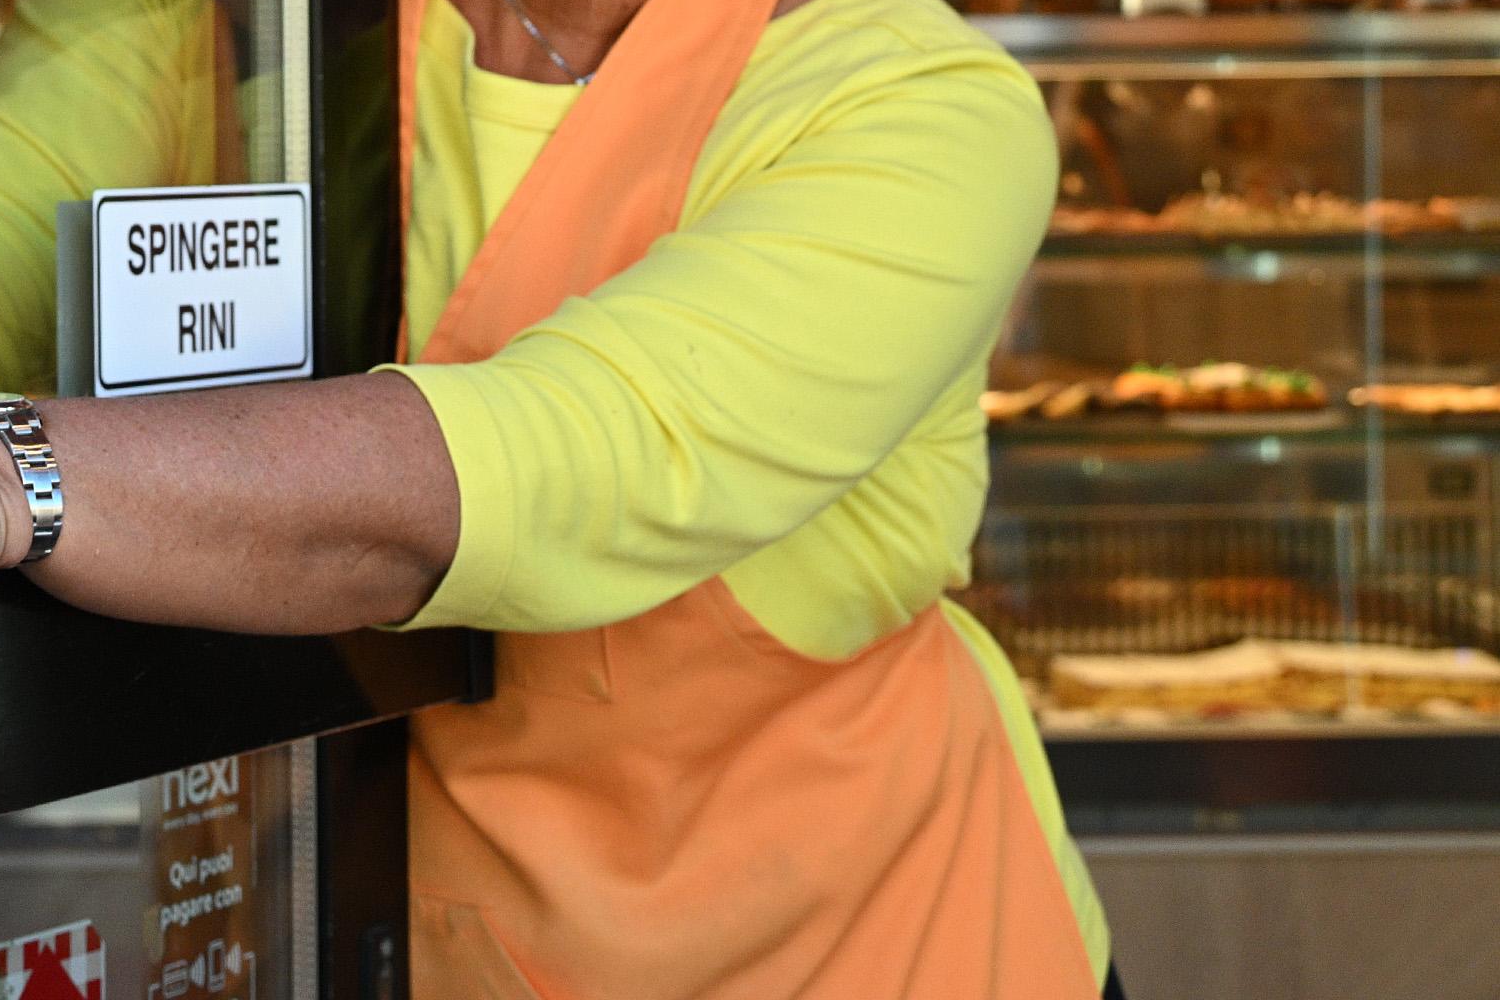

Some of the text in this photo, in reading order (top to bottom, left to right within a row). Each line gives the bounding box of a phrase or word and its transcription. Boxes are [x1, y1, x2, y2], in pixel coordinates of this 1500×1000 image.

[128, 218, 280, 276] SPINGERE
[178, 301, 235, 354] RINI
[162, 756, 239, 812] nexi
[169, 855, 198, 890] Qui
[160, 892, 213, 931] pagare
